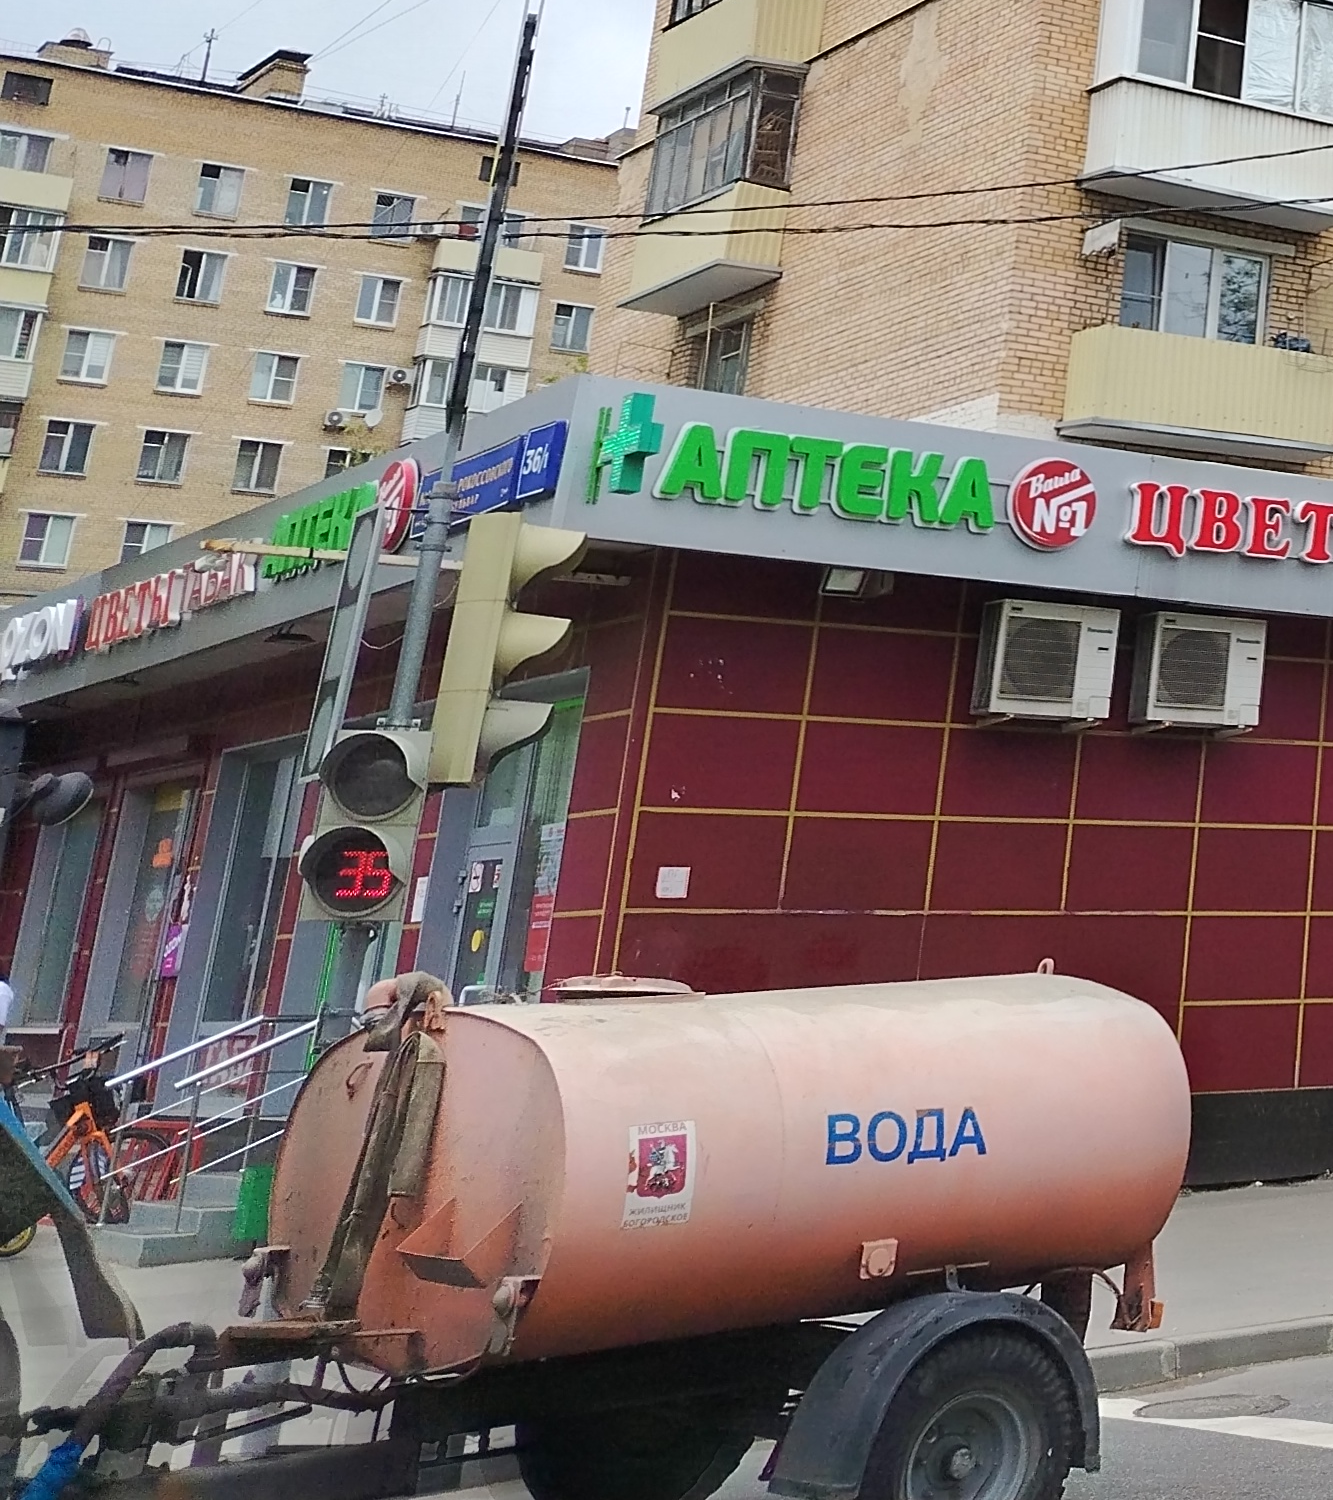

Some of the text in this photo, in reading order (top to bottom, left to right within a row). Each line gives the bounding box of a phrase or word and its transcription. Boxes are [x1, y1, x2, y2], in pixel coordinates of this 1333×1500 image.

[522, 443, 550, 475] 36/1
[656, 422, 994, 531] АПТЕКА
[1020, 468, 1081, 498] Ваша
[85, 569, 184, 651] ЦВЕТЫ
[0, 599, 78, 680] OZON
[335, 851, 392, 897] 35
[637, 1121, 687, 1136] МОСКВА
[825, 1106, 988, 1165] ВОДА
[622, 1212, 688, 1228] БОГОРОДСКОЕ
[628, 1202, 687, 1216] ЖИЛИЩНИК
